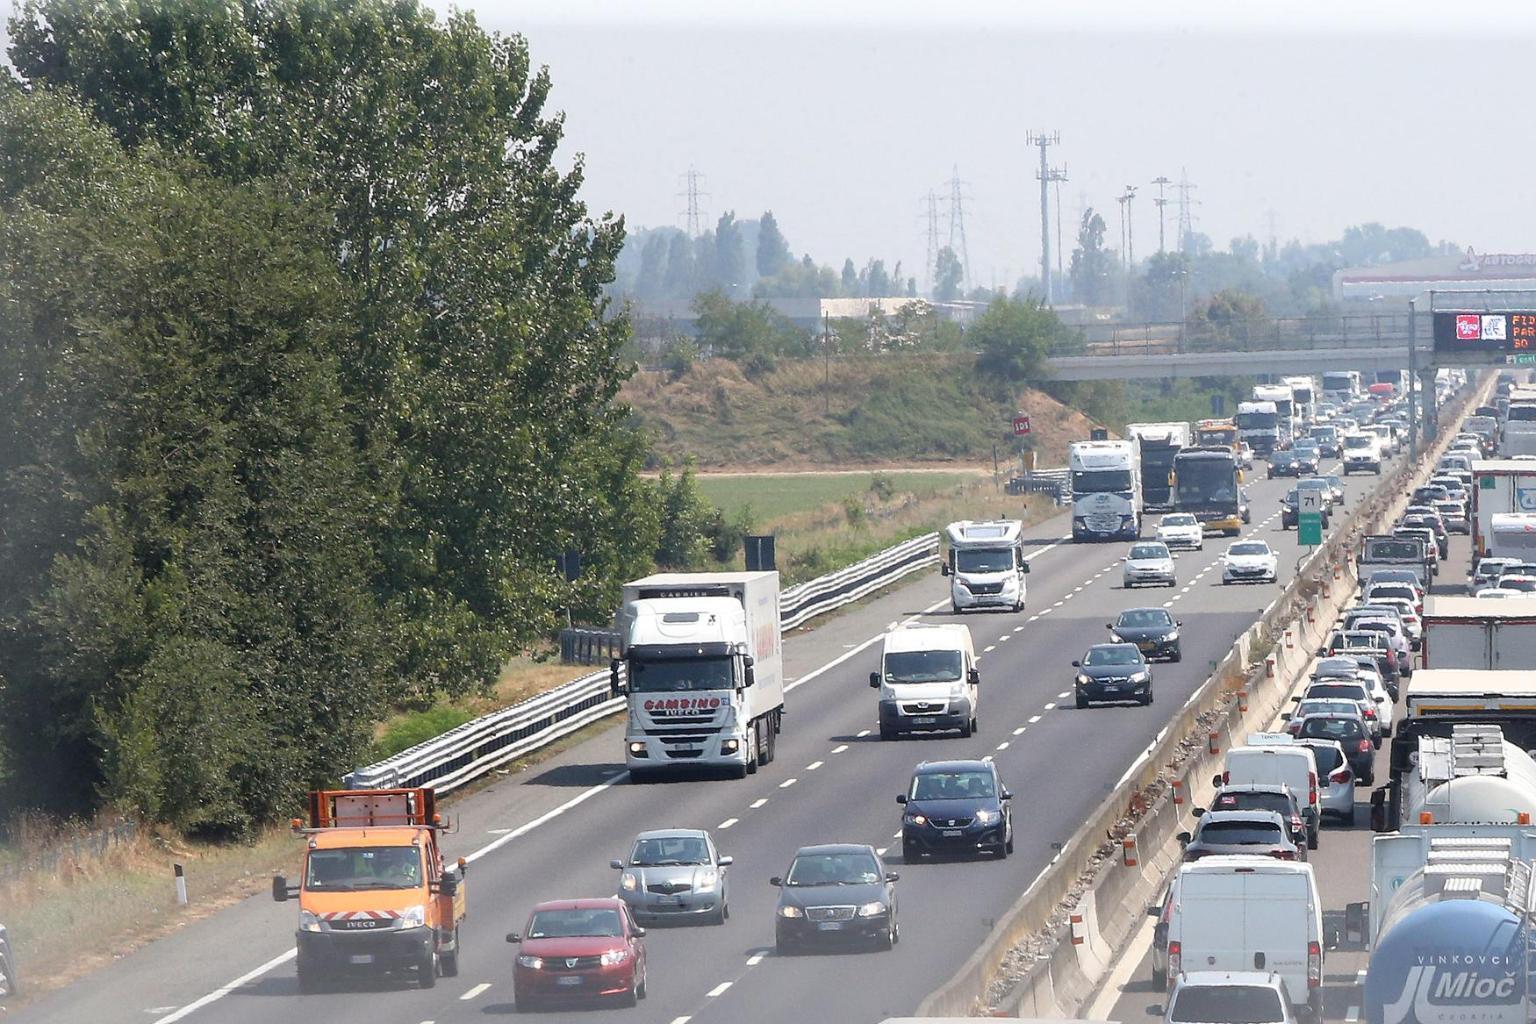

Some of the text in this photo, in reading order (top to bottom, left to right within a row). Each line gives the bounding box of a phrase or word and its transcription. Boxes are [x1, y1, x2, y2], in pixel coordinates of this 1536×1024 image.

[1304, 497, 1314, 506] 71
[1418, 955, 1509, 965] VINKOVCI
[1435, 971, 1517, 998] Mioč
